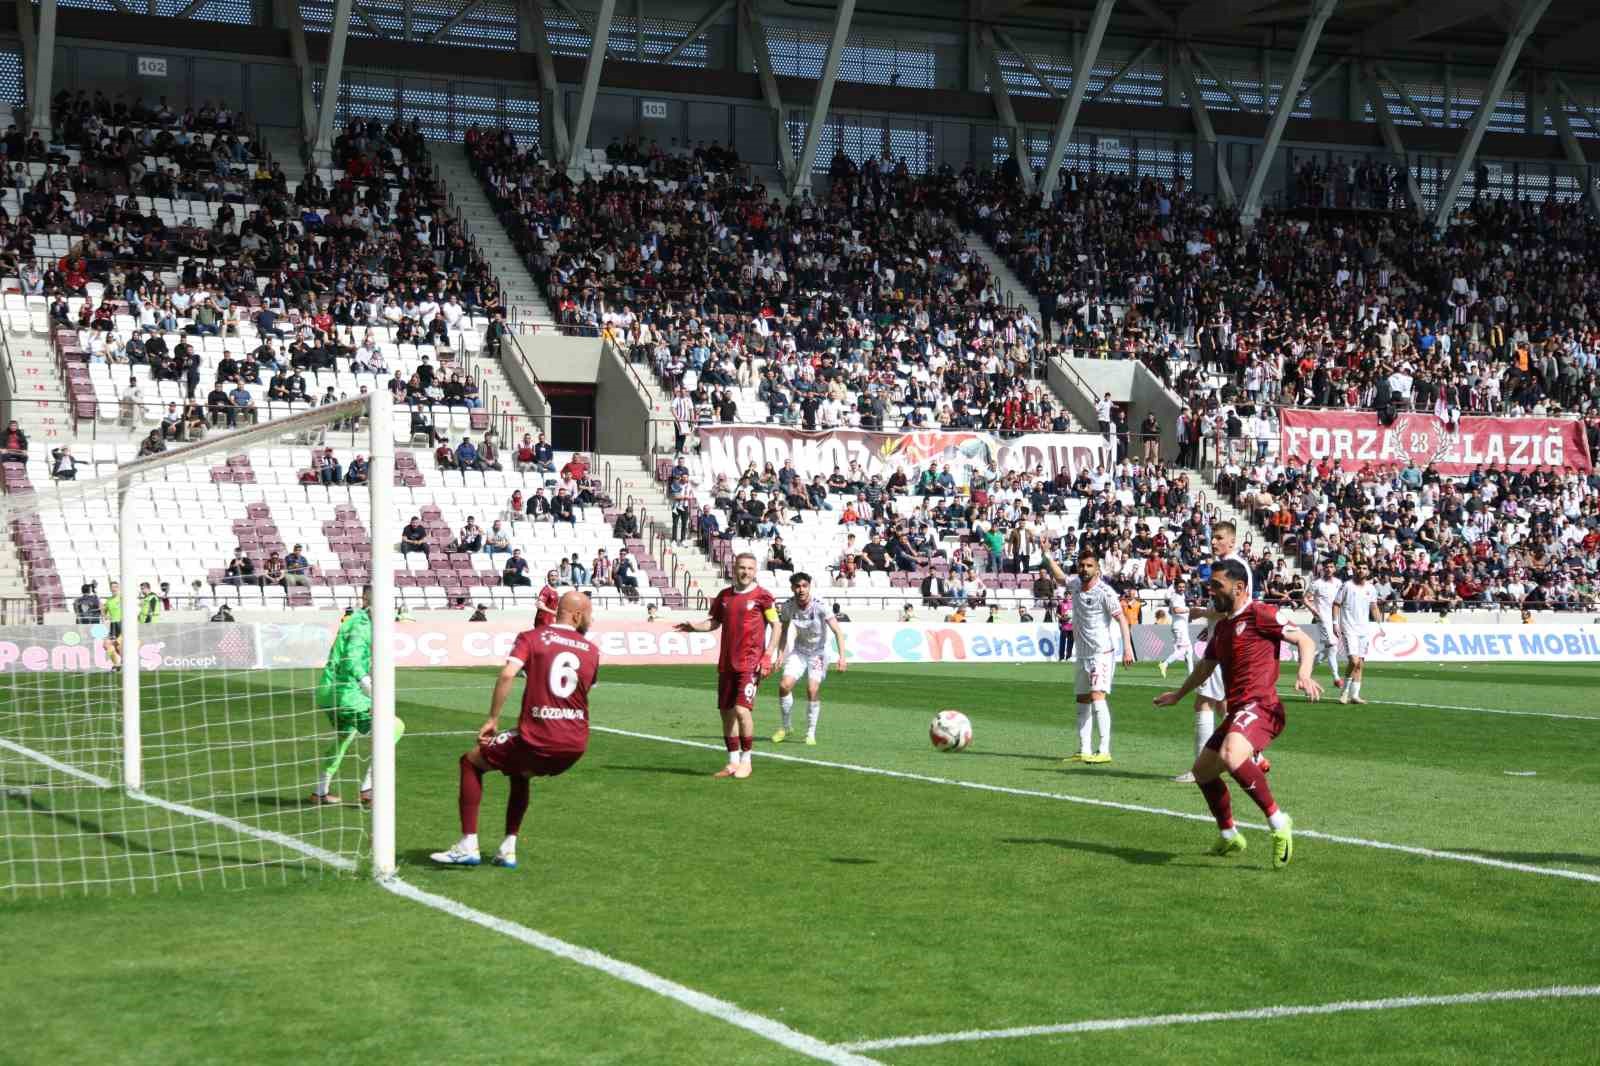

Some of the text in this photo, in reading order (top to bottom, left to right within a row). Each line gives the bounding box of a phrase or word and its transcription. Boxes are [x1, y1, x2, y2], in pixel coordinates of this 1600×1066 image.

[141, 61, 165, 72] 102
[646, 104, 665, 116] 103
[1286, 426, 1397, 461] FORZA
[1444, 428, 1563, 466] ELAZIĞ
[593, 632, 717, 656] EBAP
[1423, 633, 1512, 656] SAMET
[1518, 628, 1600, 656] MOBİL
[164, 655, 217, 669] Concept
[549, 651, 581, 699] 6
